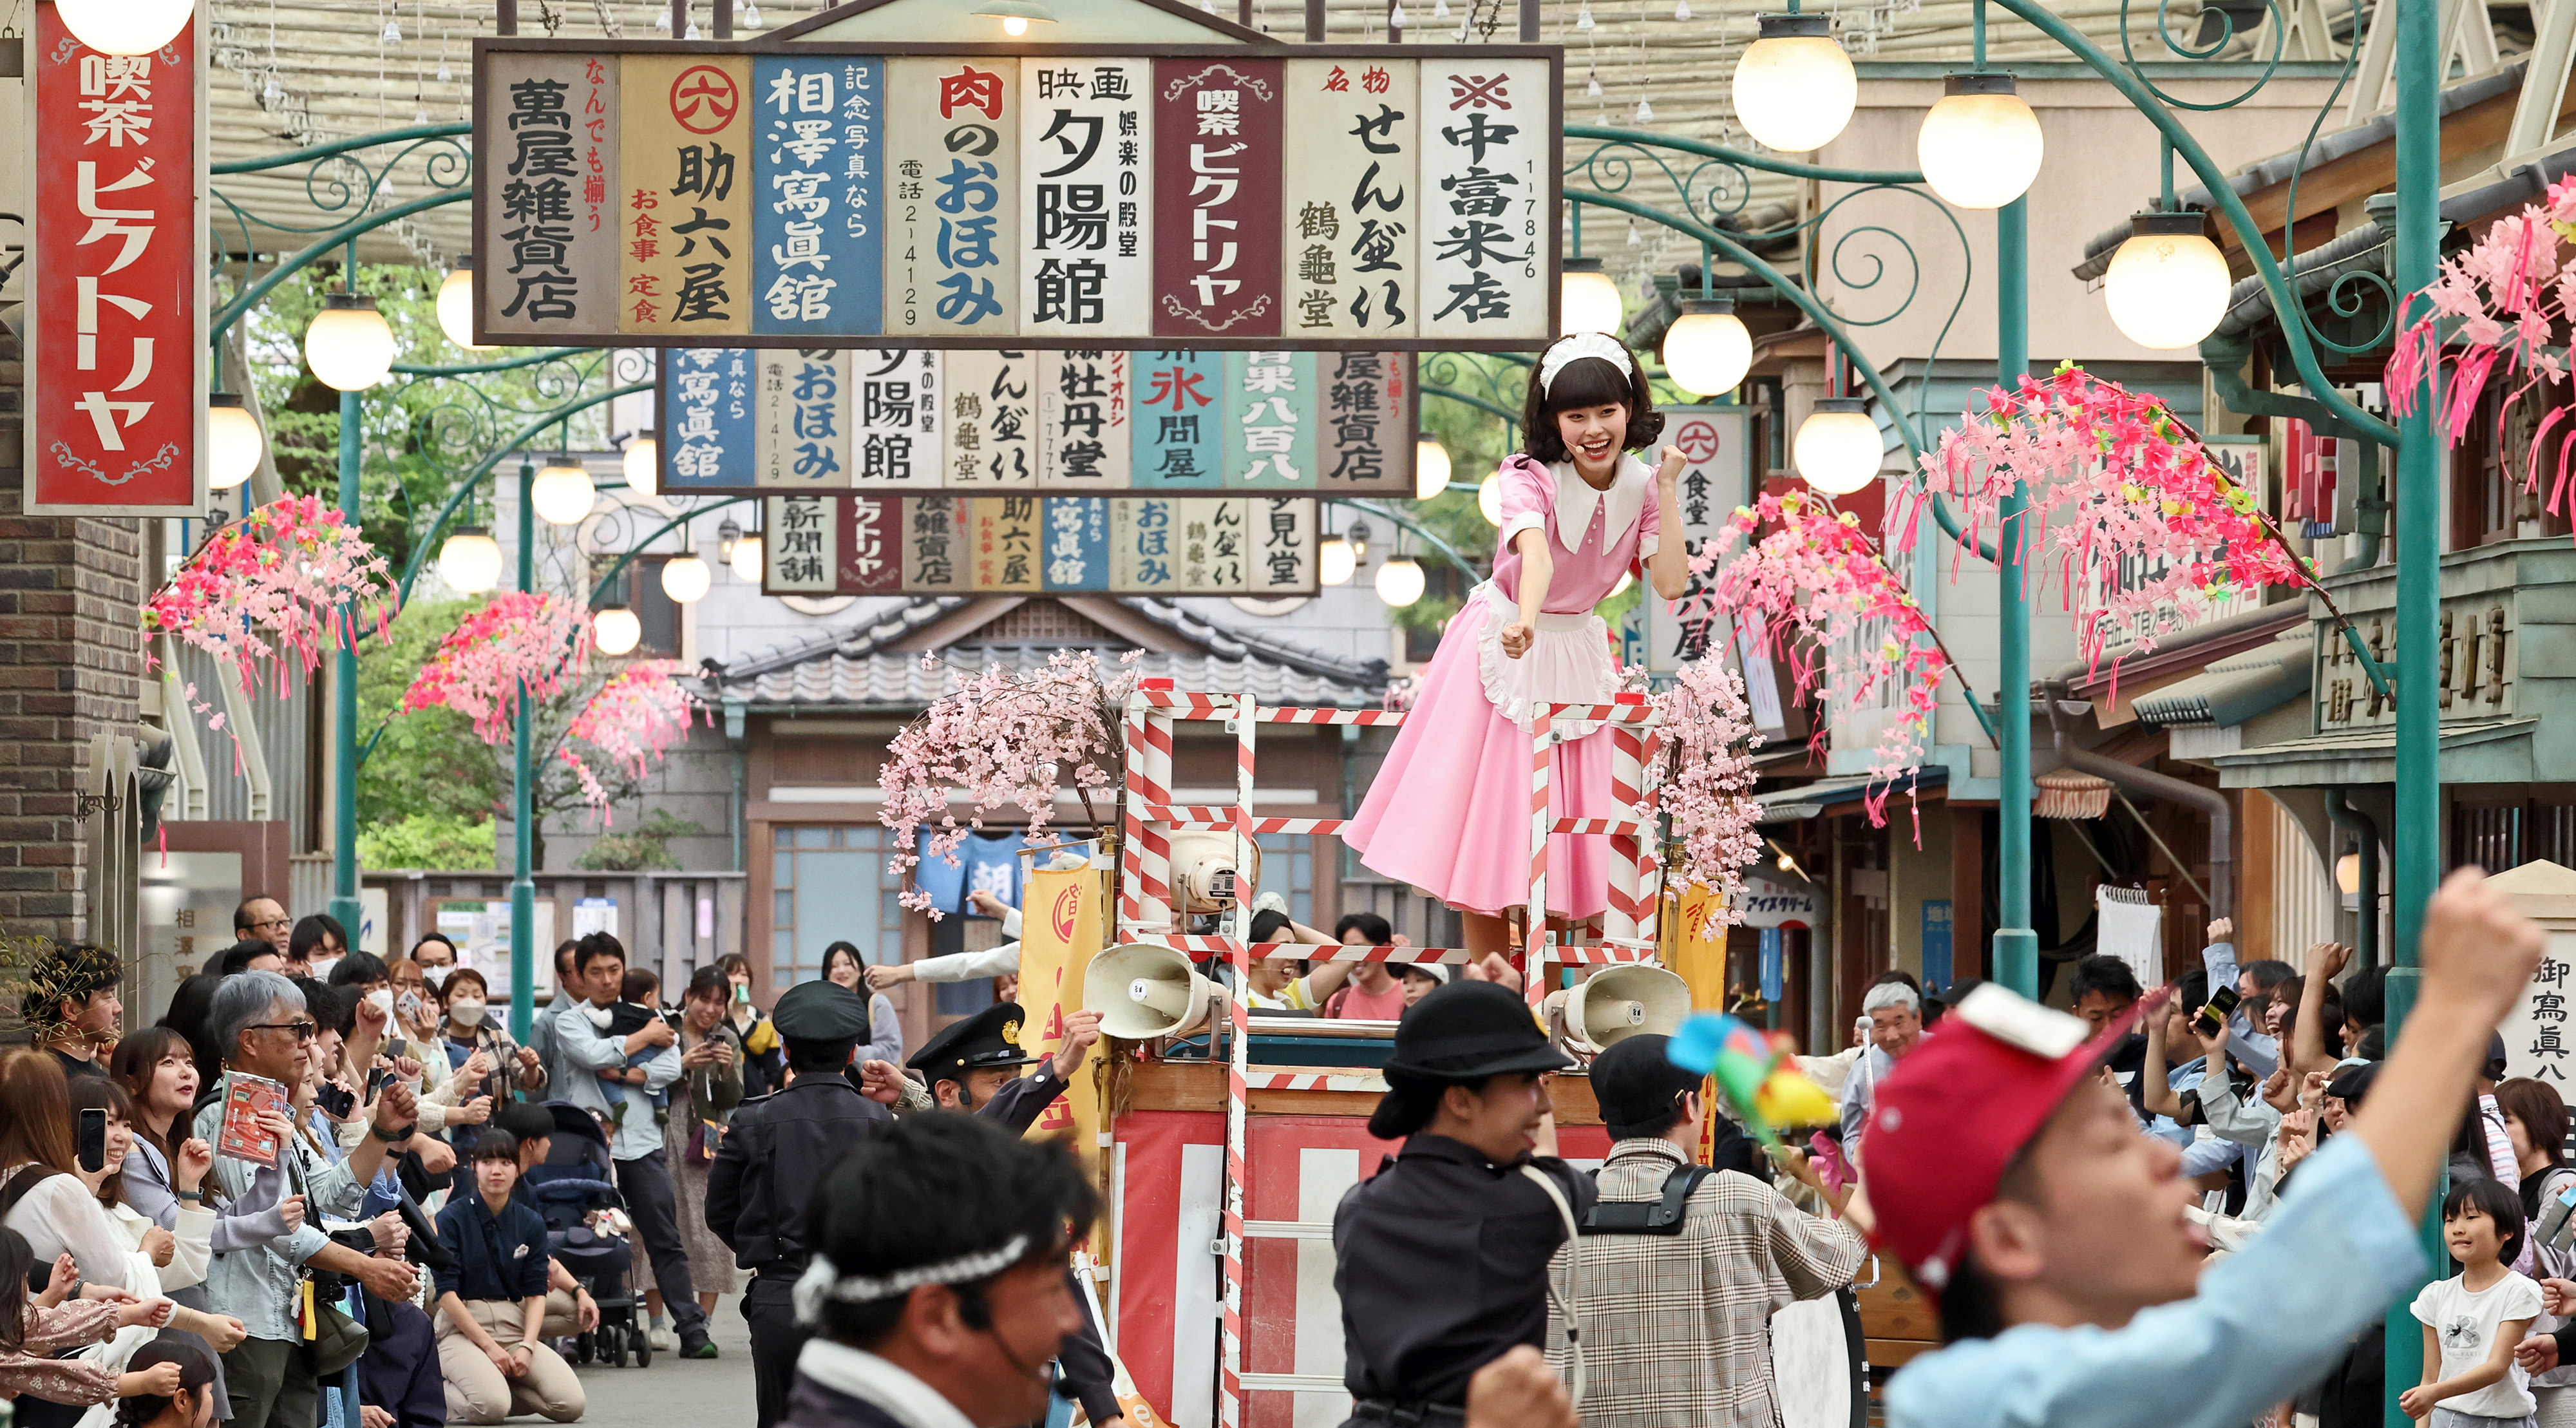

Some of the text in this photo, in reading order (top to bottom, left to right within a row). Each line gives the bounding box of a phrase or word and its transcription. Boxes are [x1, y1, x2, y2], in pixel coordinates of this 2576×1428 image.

[583, 57, 607, 233] なんでも揃う
[844, 65, 871, 238] 記念写真なら
[1038, 67, 1132, 100] 映画
[1321, 65, 1390, 93] 名物
[74, 54, 156, 452] 喫茶 ビクトリヤ
[501, 78, 579, 323] 萬屋雑貨店
[629, 189, 661, 323] お食事 定食
[670, 141, 735, 322] 助六屋
[1032, 108, 1110, 325] 夕陽館
[1119, 111, 1137, 256] 娯楽の殿堂
[1188, 90, 1248, 307] 喫茶 ビクトリヤ
[1432, 113, 1524, 321] 中富米店
[1059, 350, 1108, 478] 牡丹堂
[1387, 352, 1403, 418] も揃う
[1137, 500, 1171, 585] おほみ
[1683, 468, 1712, 526] 食堂
